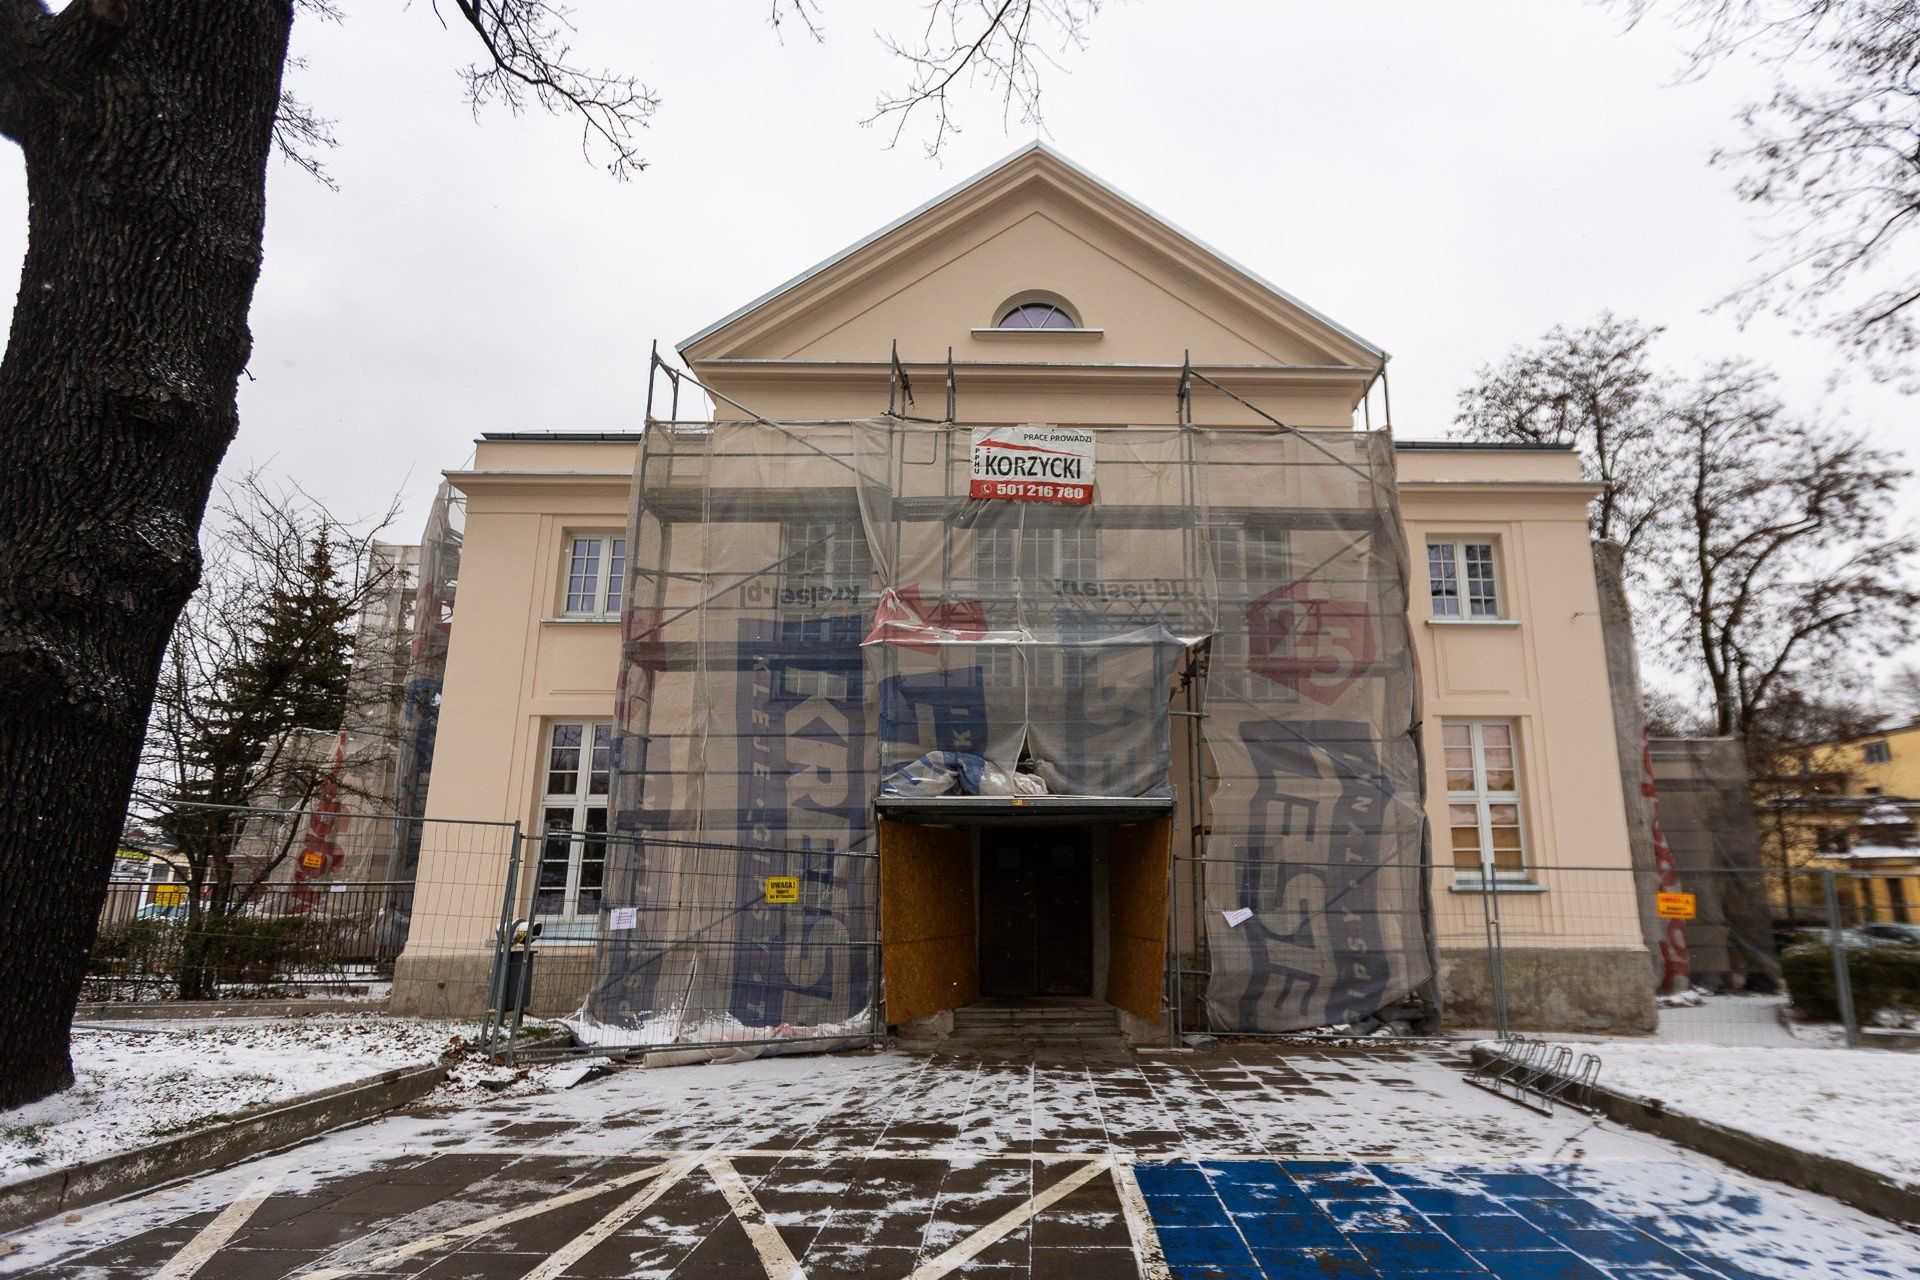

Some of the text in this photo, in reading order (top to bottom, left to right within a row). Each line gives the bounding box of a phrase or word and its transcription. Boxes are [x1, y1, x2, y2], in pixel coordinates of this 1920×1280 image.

[1023, 433, 1092, 443] PRACE PROWADZI
[973, 447, 981, 475] PPHU
[985, 455, 1081, 479] KORZYCKI
[997, 484, 1024, 495] 501
[1027, 485, 1054, 497] 216
[1264, 600, 1355, 687] 25
[752, 655, 772, 783] KLEJE
